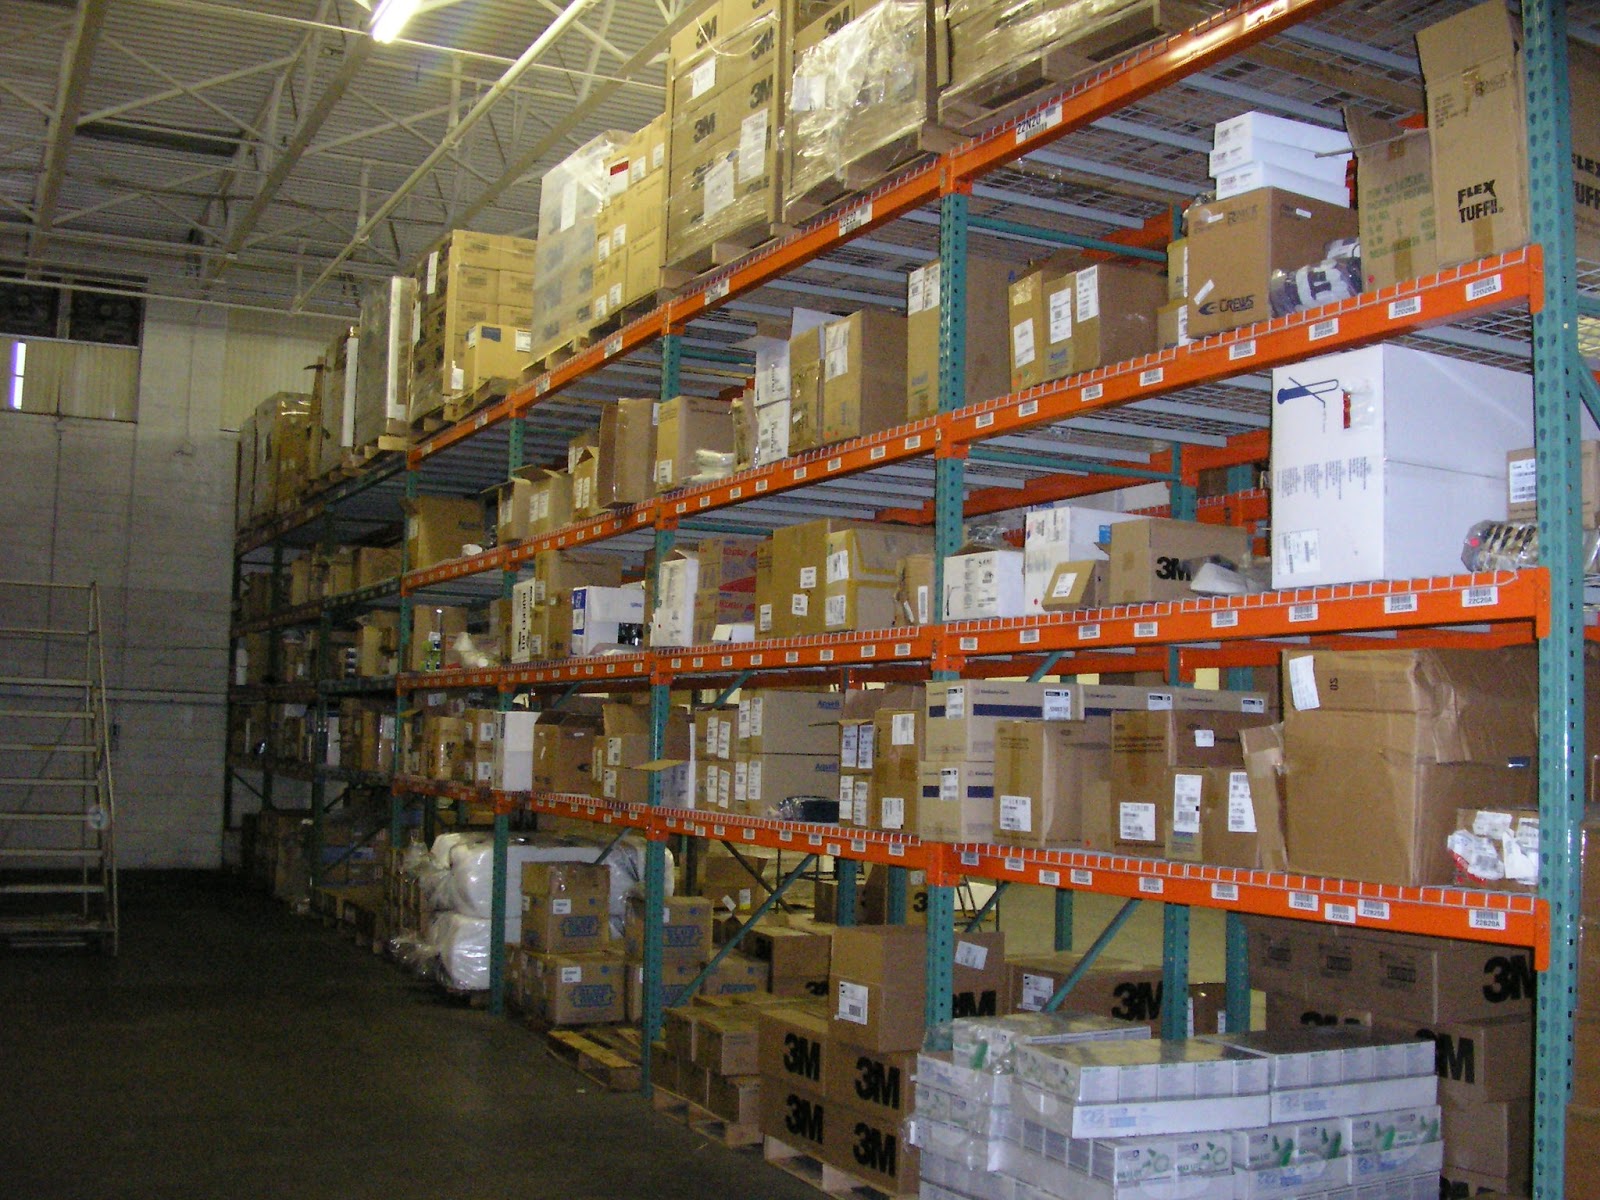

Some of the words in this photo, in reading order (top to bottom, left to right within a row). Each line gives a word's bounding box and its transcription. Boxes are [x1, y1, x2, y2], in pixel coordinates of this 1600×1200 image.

[696, 15, 717, 49] 3M
[752, 26, 774, 61] 3M
[751, 74, 773, 109] 3M
[693, 112, 715, 143] 3M
[1457, 179, 1496, 207] FLEX
[1156, 556, 1192, 581] 3M
[1475, 919, 1501, 928] 22B20A
[952, 990, 996, 1017] M
[783, 1032, 821, 1082] 3M
[855, 1056, 900, 1110] 3M
[785, 1093, 824, 1145] 3M
[853, 1122, 896, 1177] 3M
